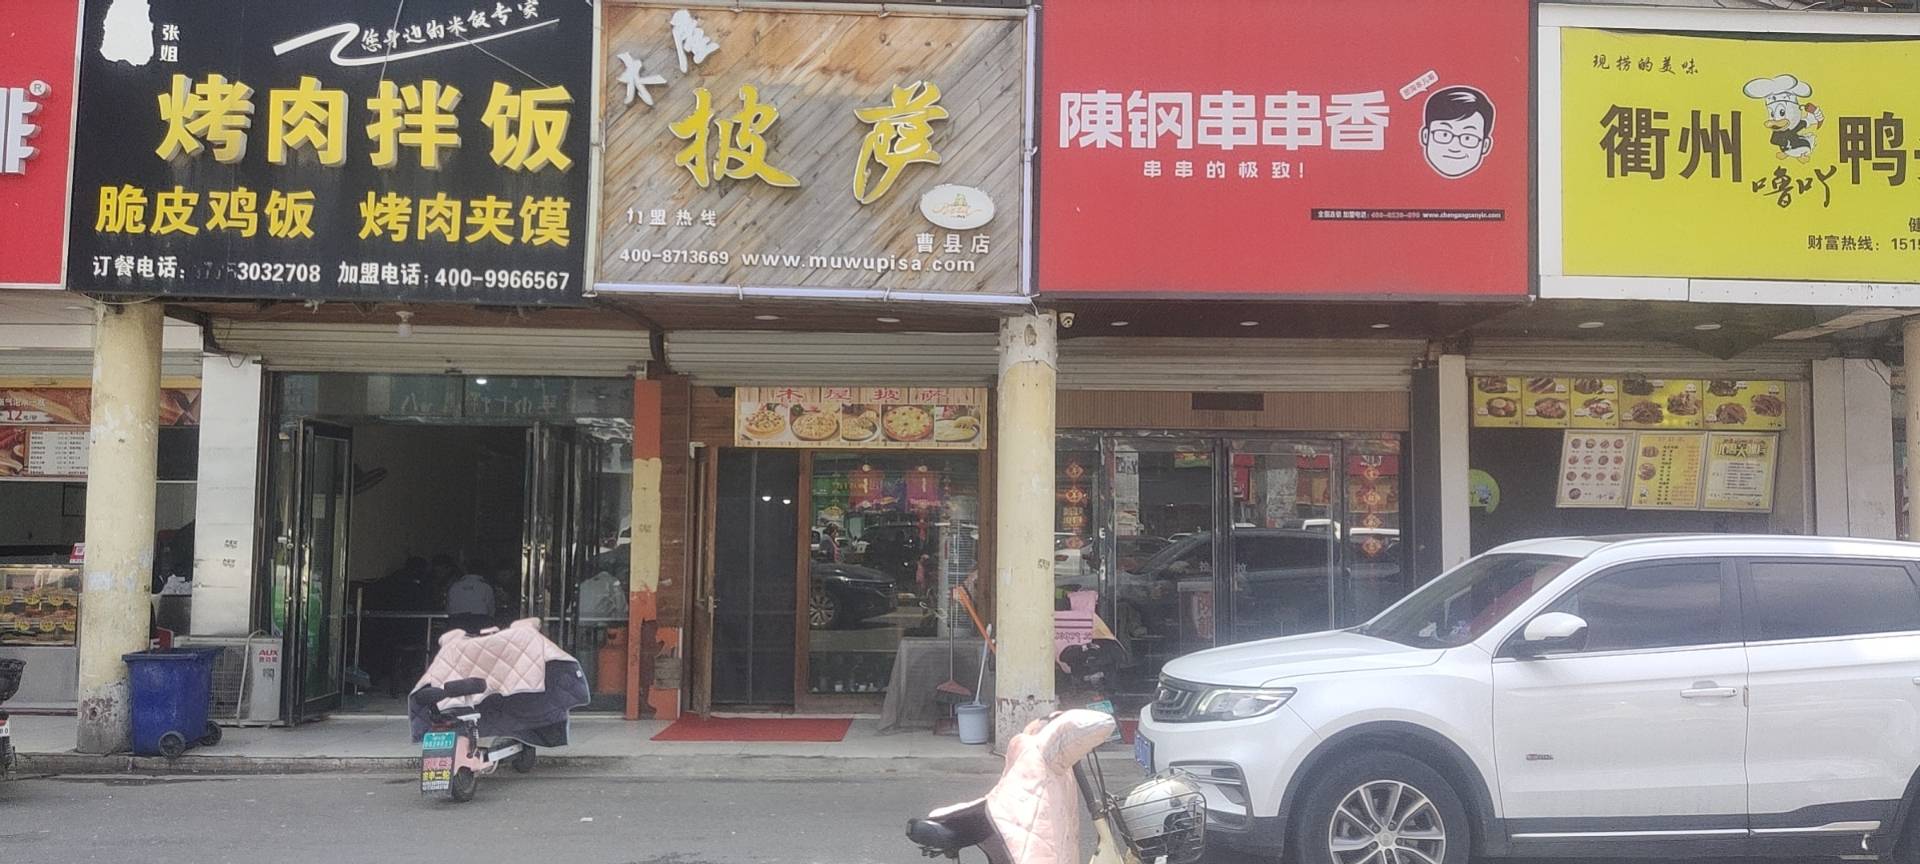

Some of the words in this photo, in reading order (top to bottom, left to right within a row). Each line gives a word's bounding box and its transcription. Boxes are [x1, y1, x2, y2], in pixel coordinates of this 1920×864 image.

[160, 24, 180, 62] 张姐
[1592, 54, 1700, 75] 现捞的美味
[155, 74, 574, 172] 烤肉拌饭
[1059, 90, 1390, 151] 陳钢串串香
[669, 80, 949, 204] 披萨
[1600, 104, 1742, 182] 衢州
[1838, 111, 1920, 187] 鸭
[1143, 161, 1304, 179] 串串的极致!
[95, 184, 315, 239] 脆皮鸡饭
[359, 190, 572, 246] 烤肉夹馍
[619, 248, 729, 265] 400-8713669
[916, 233, 990, 254] 曹县店
[1808, 234, 1879, 251] 财富热线:
[1891, 238, 1920, 251] 151
[259, 649, 278, 657] AUX
